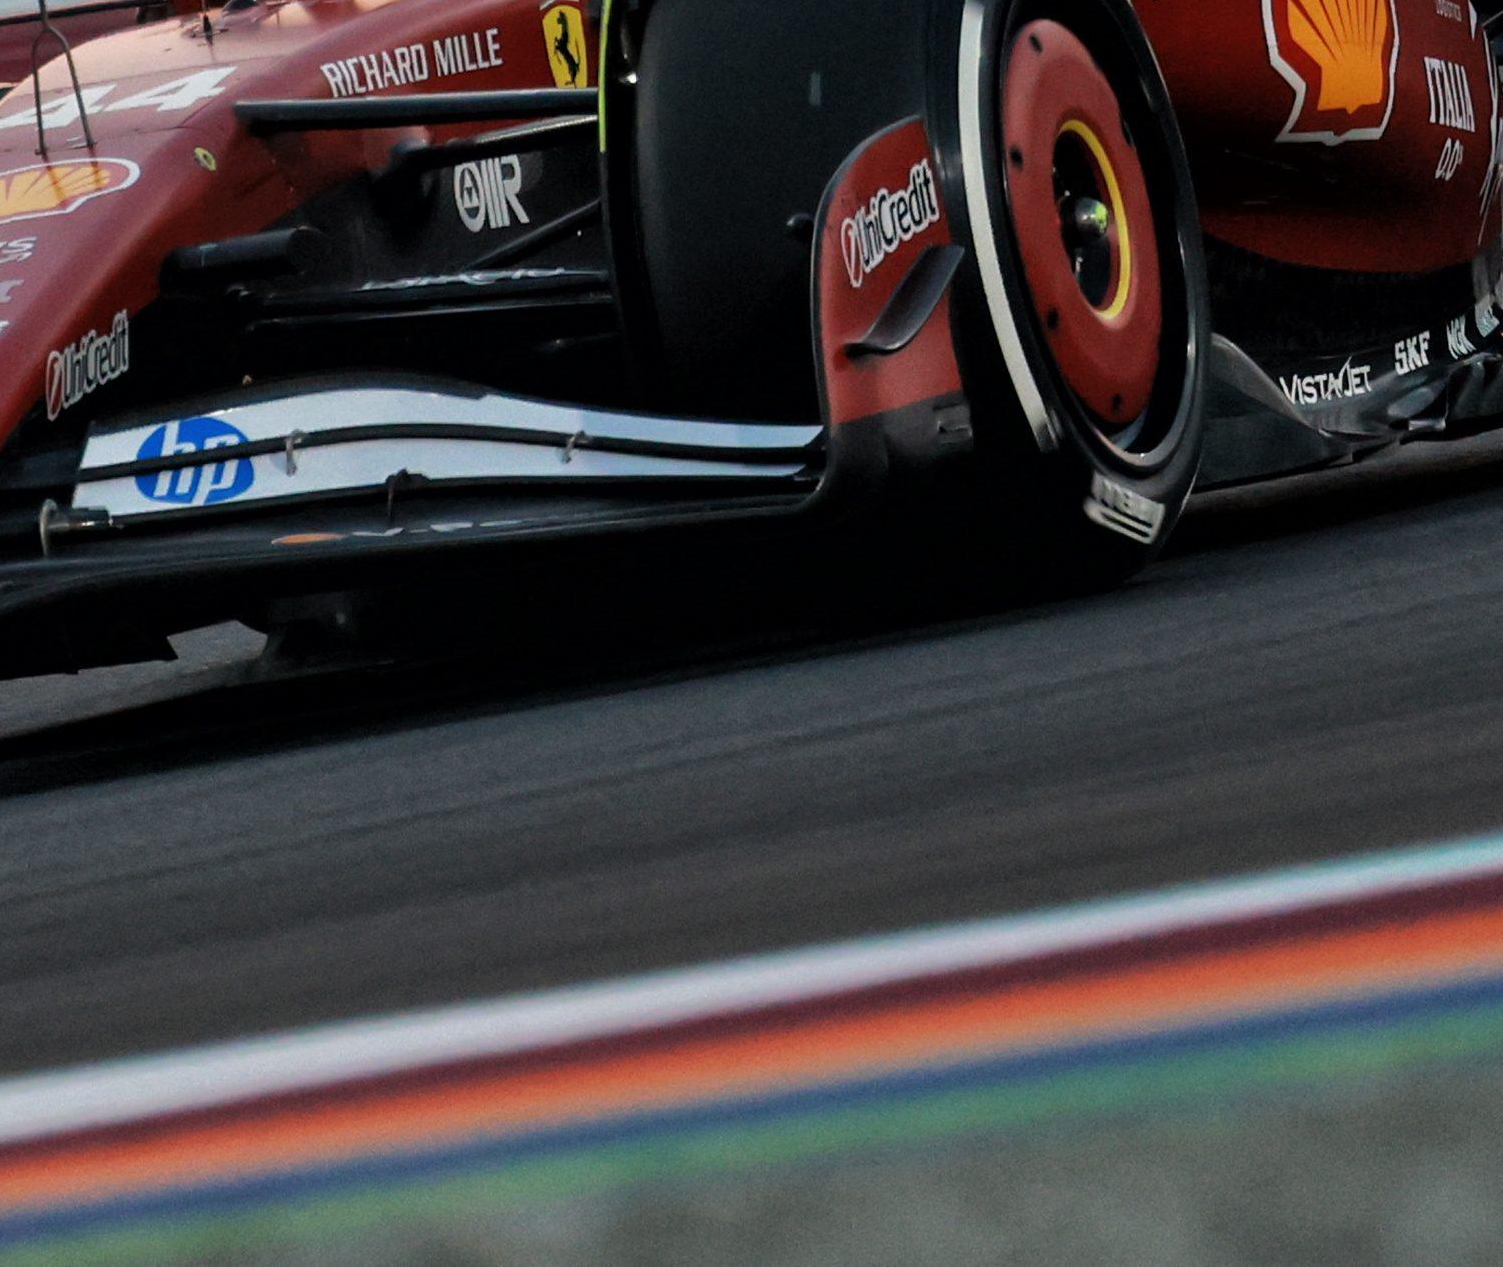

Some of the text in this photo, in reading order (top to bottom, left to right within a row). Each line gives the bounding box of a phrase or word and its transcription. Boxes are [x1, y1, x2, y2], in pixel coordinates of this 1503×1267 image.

[320, 28, 503, 98] RICHARD MILLE
[1423, 56, 1476, 133] ITALIA
[855, 160, 939, 272] UniCredit
[62, 309, 129, 409] UniCredit
[1395, 331, 1431, 377] SKF
[152, 420, 240, 506] hp
